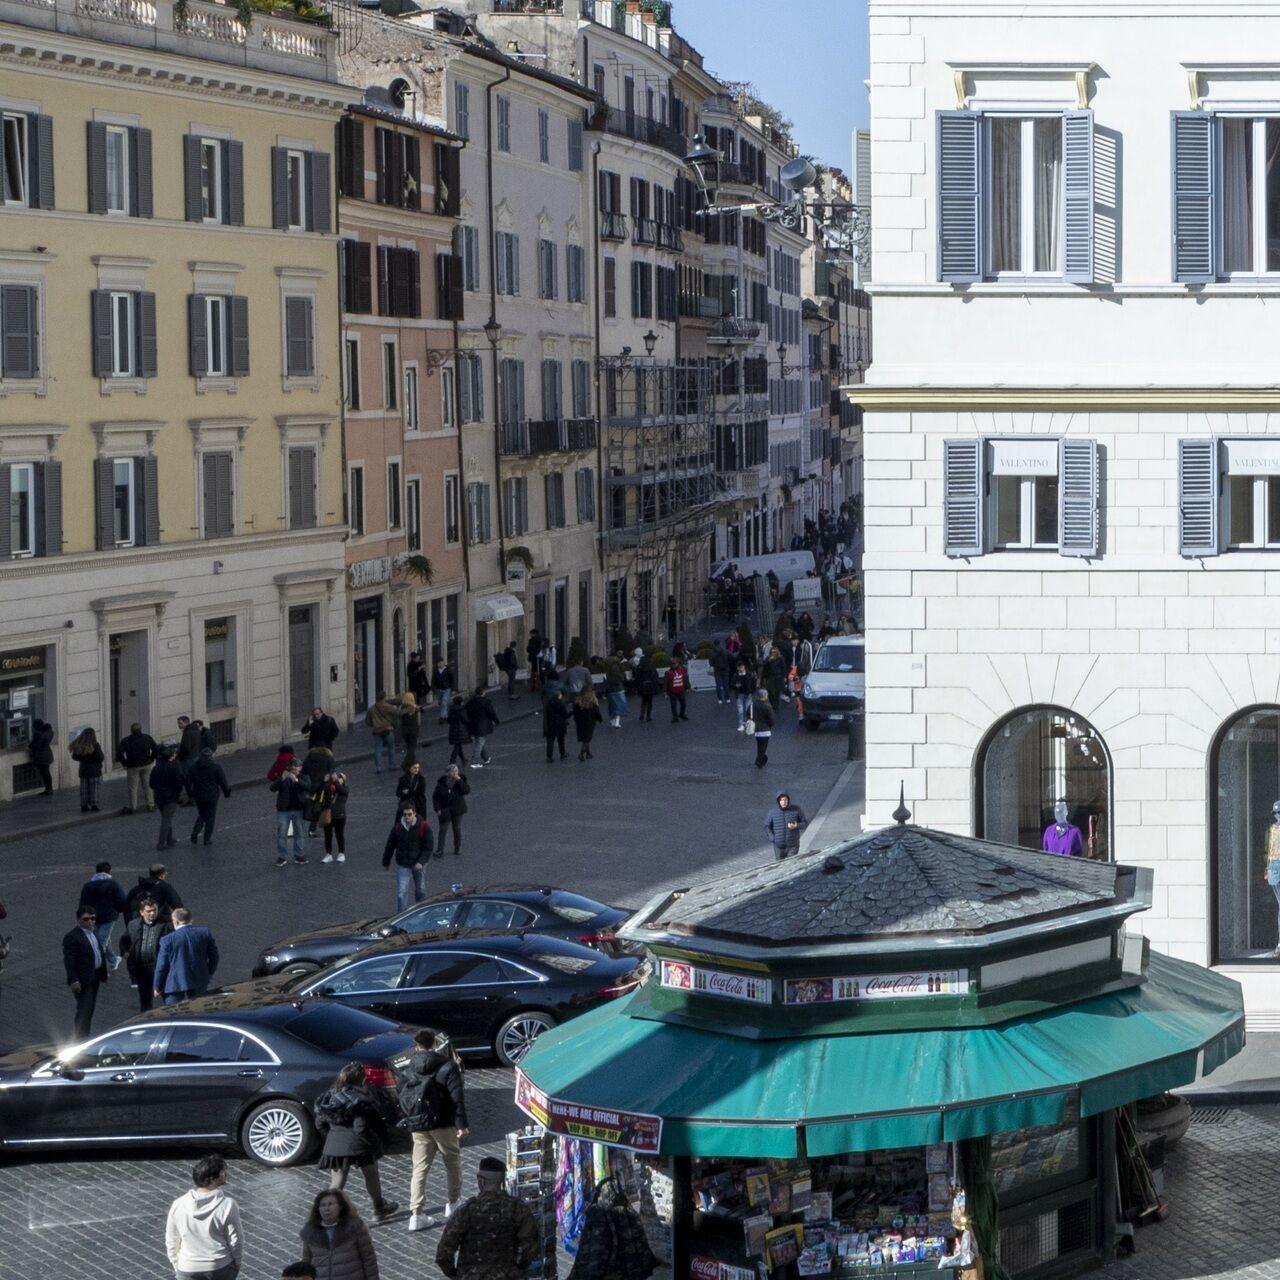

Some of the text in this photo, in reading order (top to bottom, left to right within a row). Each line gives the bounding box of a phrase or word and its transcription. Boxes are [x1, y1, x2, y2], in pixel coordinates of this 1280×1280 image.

[1000, 458, 1049, 467] VALENTINO
[580, 1109, 592, 1120] ARE
[593, 1110, 620, 1125] OFFICIAL
